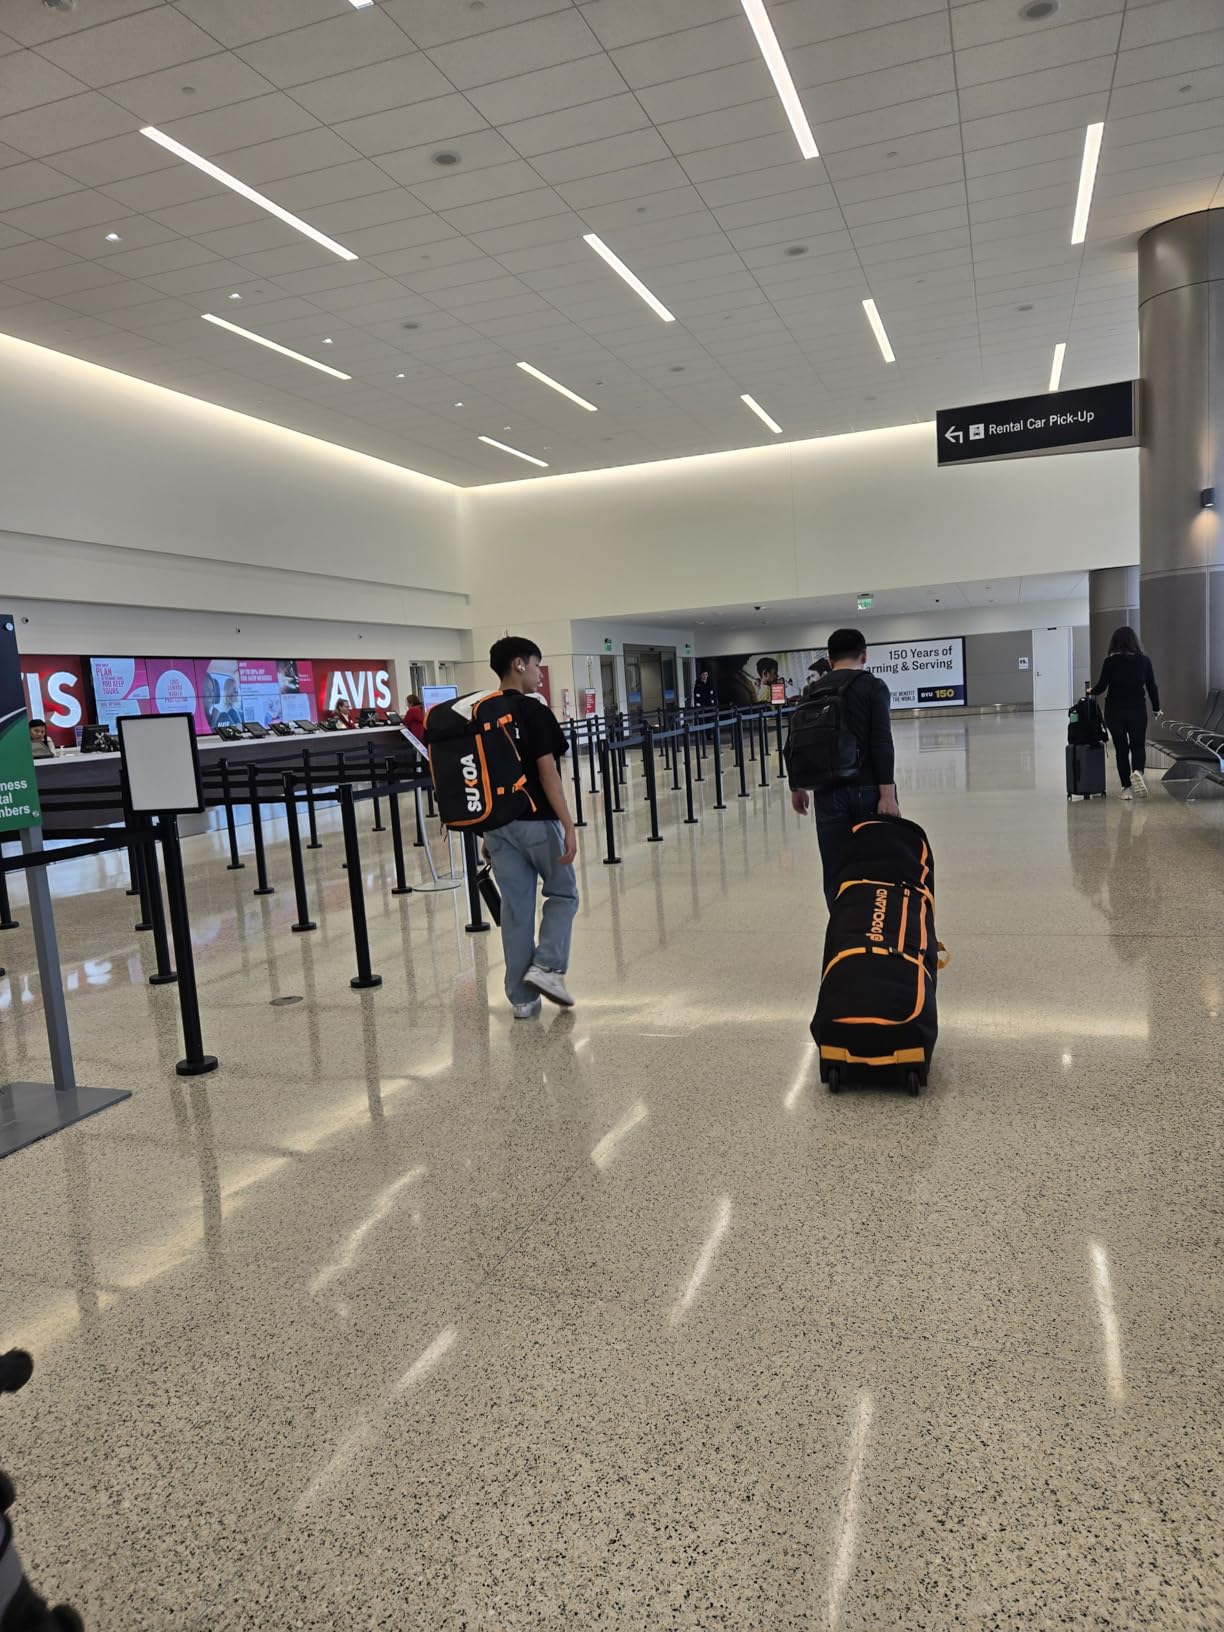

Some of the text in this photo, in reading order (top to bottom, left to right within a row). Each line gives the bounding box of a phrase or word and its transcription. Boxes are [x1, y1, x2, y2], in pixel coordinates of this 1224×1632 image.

[989, 410, 1095, 435] Rental Car Pick-Up
[888, 645, 952, 660] 150 Years of
[866, 659, 953, 674] arning & Serving
[328, 670, 391, 711] AVIS
[934, 689, 955, 698] 150
[20, 671, 82, 728] IS
[0, 780, 28, 792] ness
